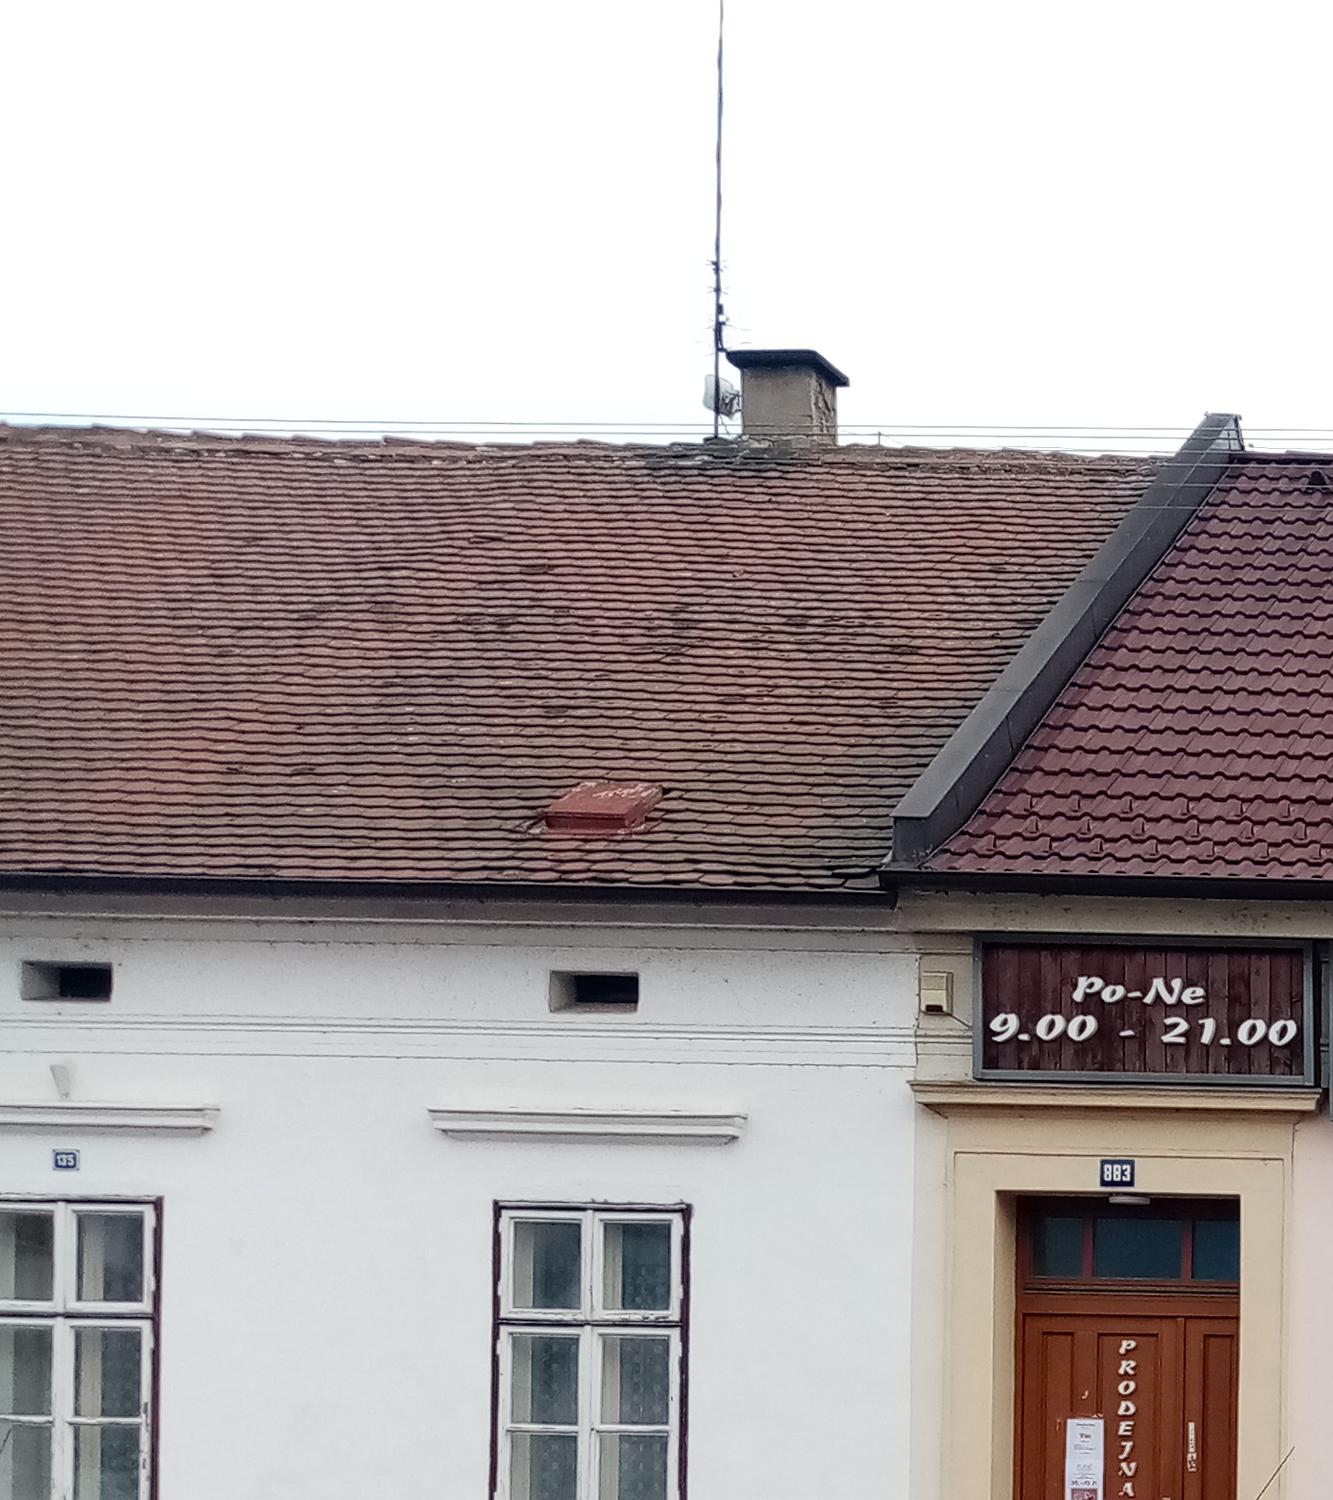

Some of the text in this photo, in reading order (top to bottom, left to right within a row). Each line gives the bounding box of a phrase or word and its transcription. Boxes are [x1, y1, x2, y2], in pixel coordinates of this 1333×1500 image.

[1072, 975, 1206, 1005] Po-Ne
[989, 1013, 1098, 1043] 9.00
[1160, 1016, 1298, 1046] 21.00
[1103, 1164, 1131, 1182] 883
[1117, 1339, 1137, 1498] PRODEJNA
